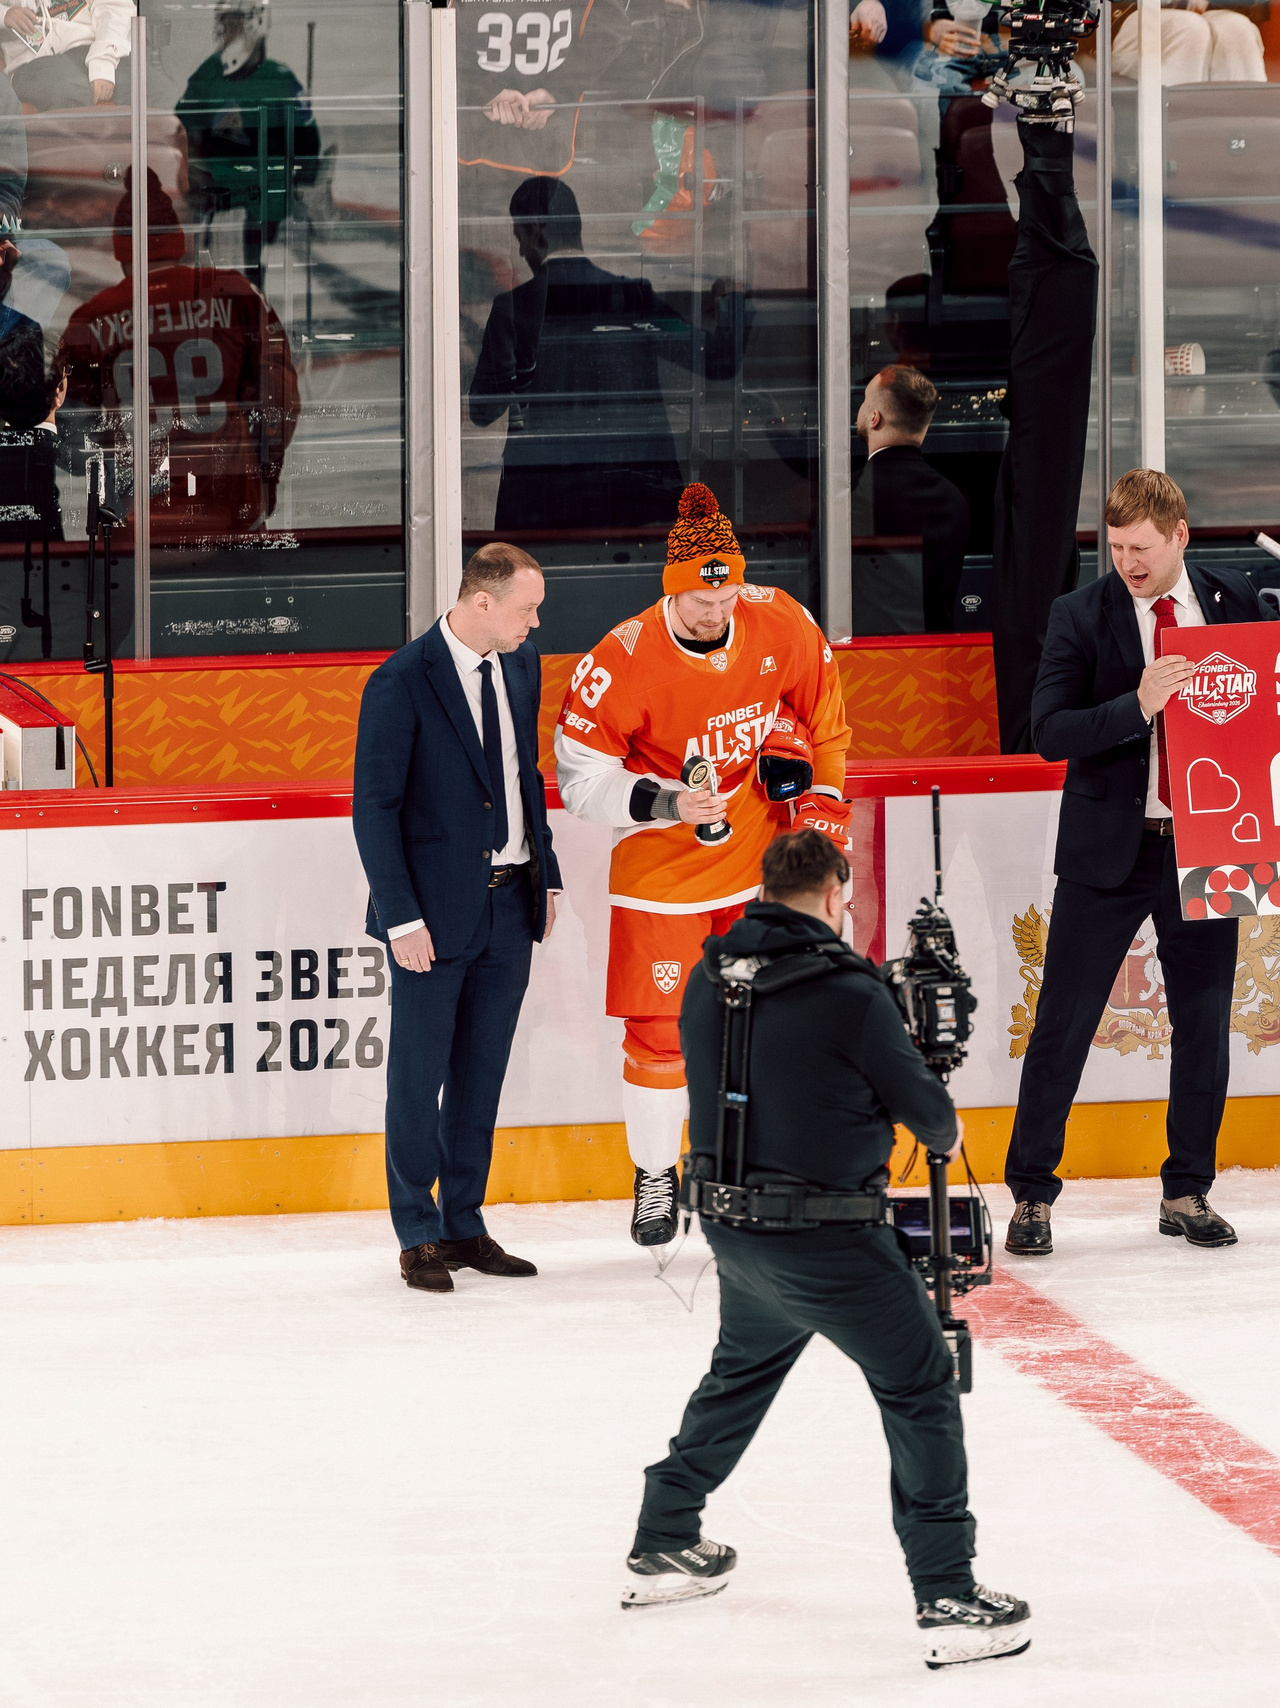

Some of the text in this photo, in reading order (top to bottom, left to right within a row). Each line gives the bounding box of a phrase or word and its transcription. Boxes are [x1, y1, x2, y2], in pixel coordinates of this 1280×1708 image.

[477, 8, 572, 75] 332
[1231, 139, 1246, 149] 24
[700, 565, 730, 577] ALL STAR
[571, 653, 612, 709] 93
[1199, 664, 1235, 673] FONBET
[1183, 673, 1253, 696] ALL STAR
[564, 709, 597, 734] BET
[707, 701, 763, 731] FONBET
[684, 730, 730, 765] ALL
[803, 817, 852, 838] SOYU
[22, 881, 226, 940] FONBET
[23, 946, 391, 1018] НЕДЕЛЯ ЗВЕЗ
[24, 1017, 383, 1082] ХОККЕЯ 2026
[681, 1549, 708, 1567] CCM
